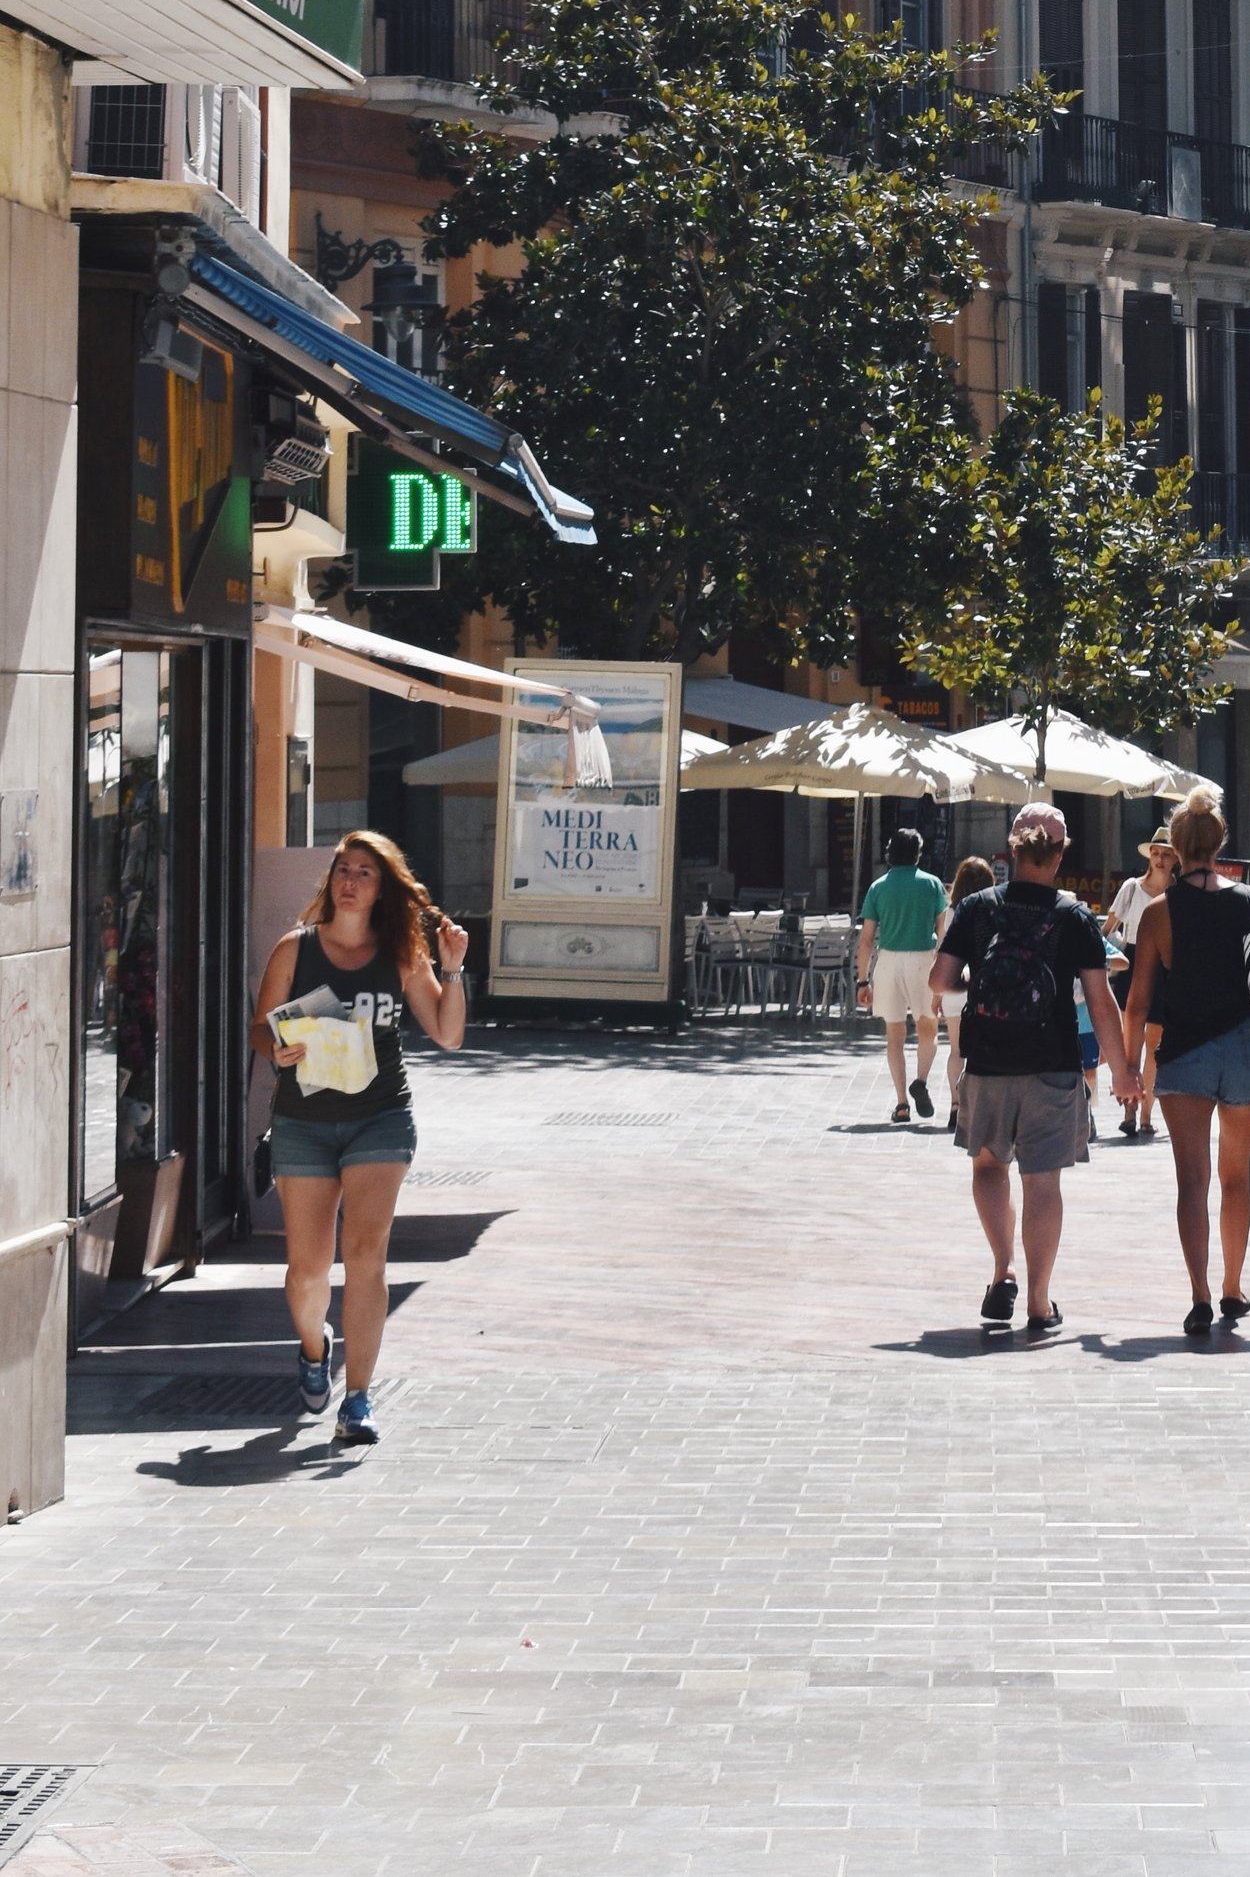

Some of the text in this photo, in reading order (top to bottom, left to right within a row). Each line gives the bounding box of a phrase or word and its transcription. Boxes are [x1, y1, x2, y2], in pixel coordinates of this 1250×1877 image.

[897, 701, 940, 715] TABACOS
[541, 810, 603, 829] MEDI
[541, 850, 594, 870] NEO
